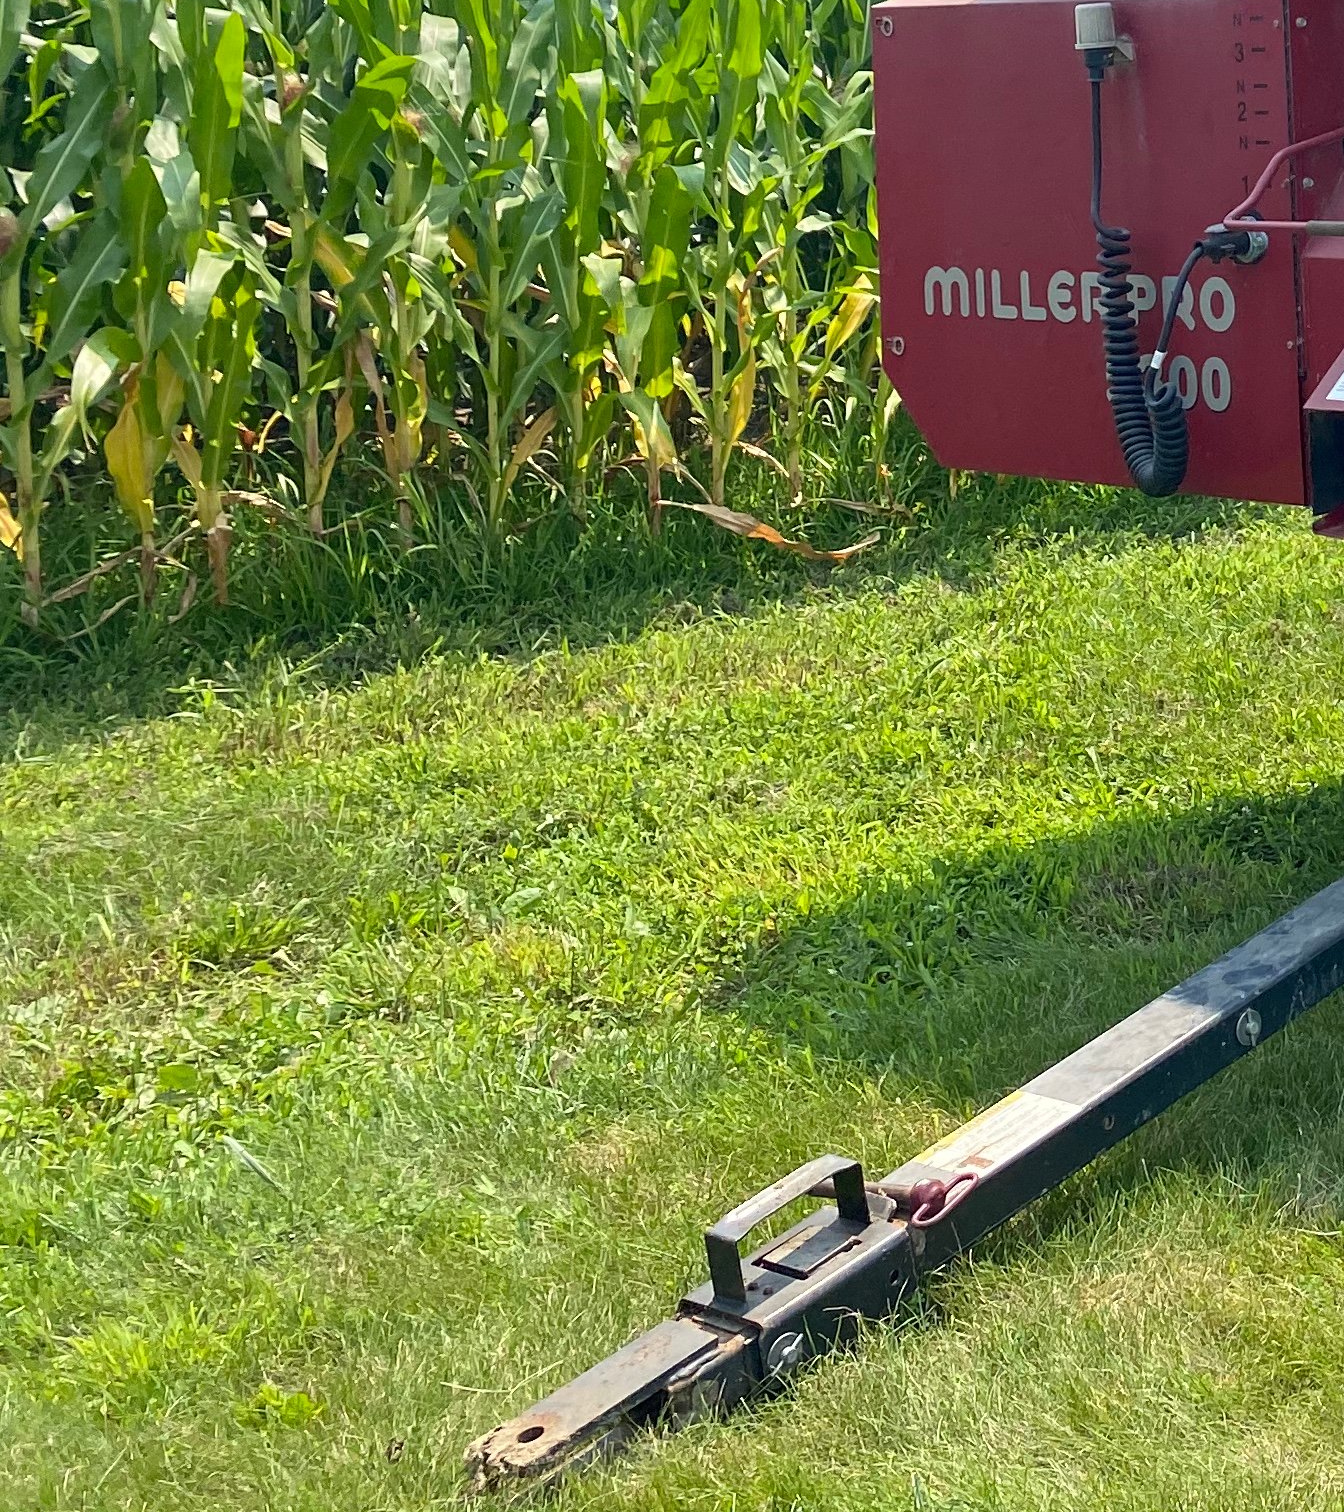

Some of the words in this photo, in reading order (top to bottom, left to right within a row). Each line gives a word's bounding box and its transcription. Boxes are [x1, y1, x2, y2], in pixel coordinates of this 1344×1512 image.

[1234, 42, 1244, 63] 3
[1236, 80, 1245, 94] N
[1238, 102, 1247, 122] 2
[1239, 136, 1249, 150] N
[923, 265, 1112, 324] MILLER
[1124, 273, 1236, 333] PRO
